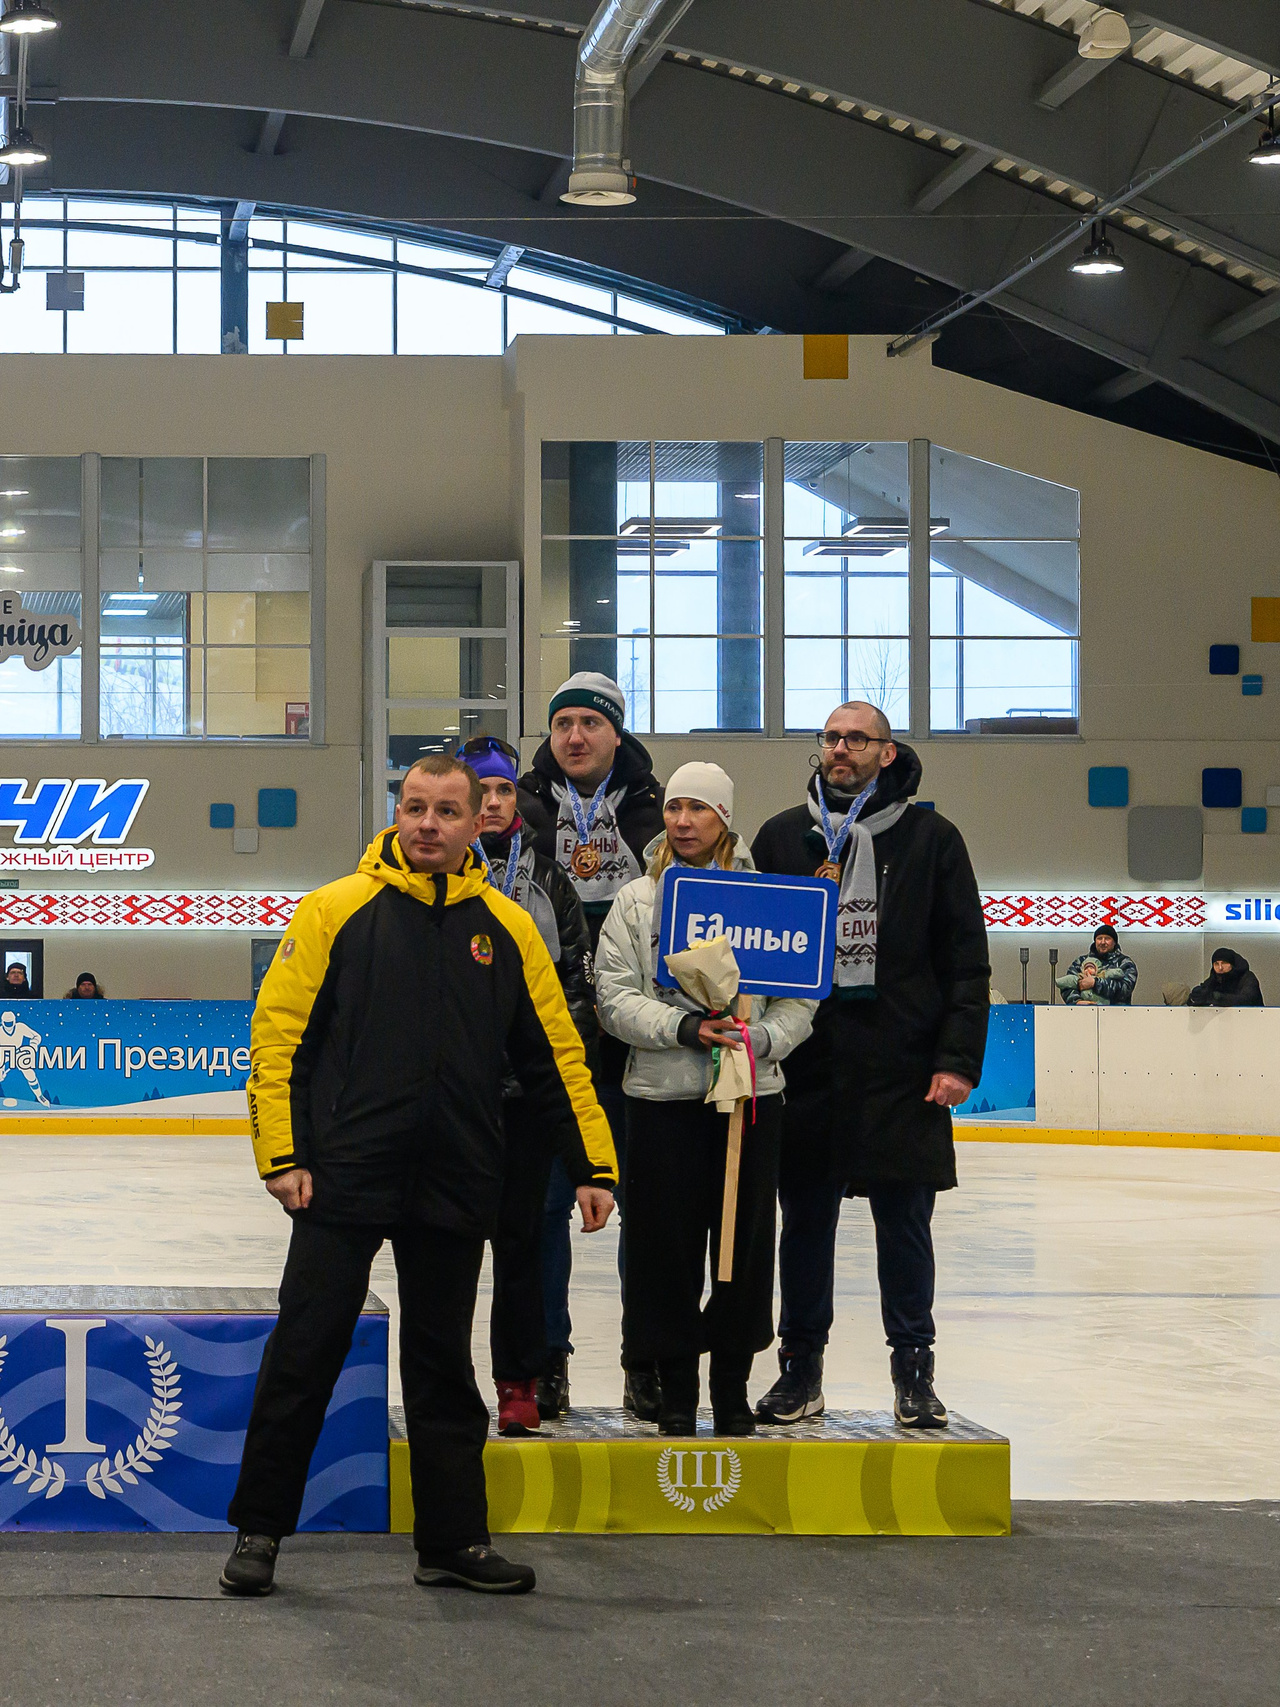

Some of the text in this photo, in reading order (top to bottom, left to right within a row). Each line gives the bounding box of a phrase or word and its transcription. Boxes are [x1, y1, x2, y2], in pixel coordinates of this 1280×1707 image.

[80, 853, 150, 869] ЦЕНТР
[686, 912, 809, 955] Единые
[842, 919, 878, 939] ЕДИ
